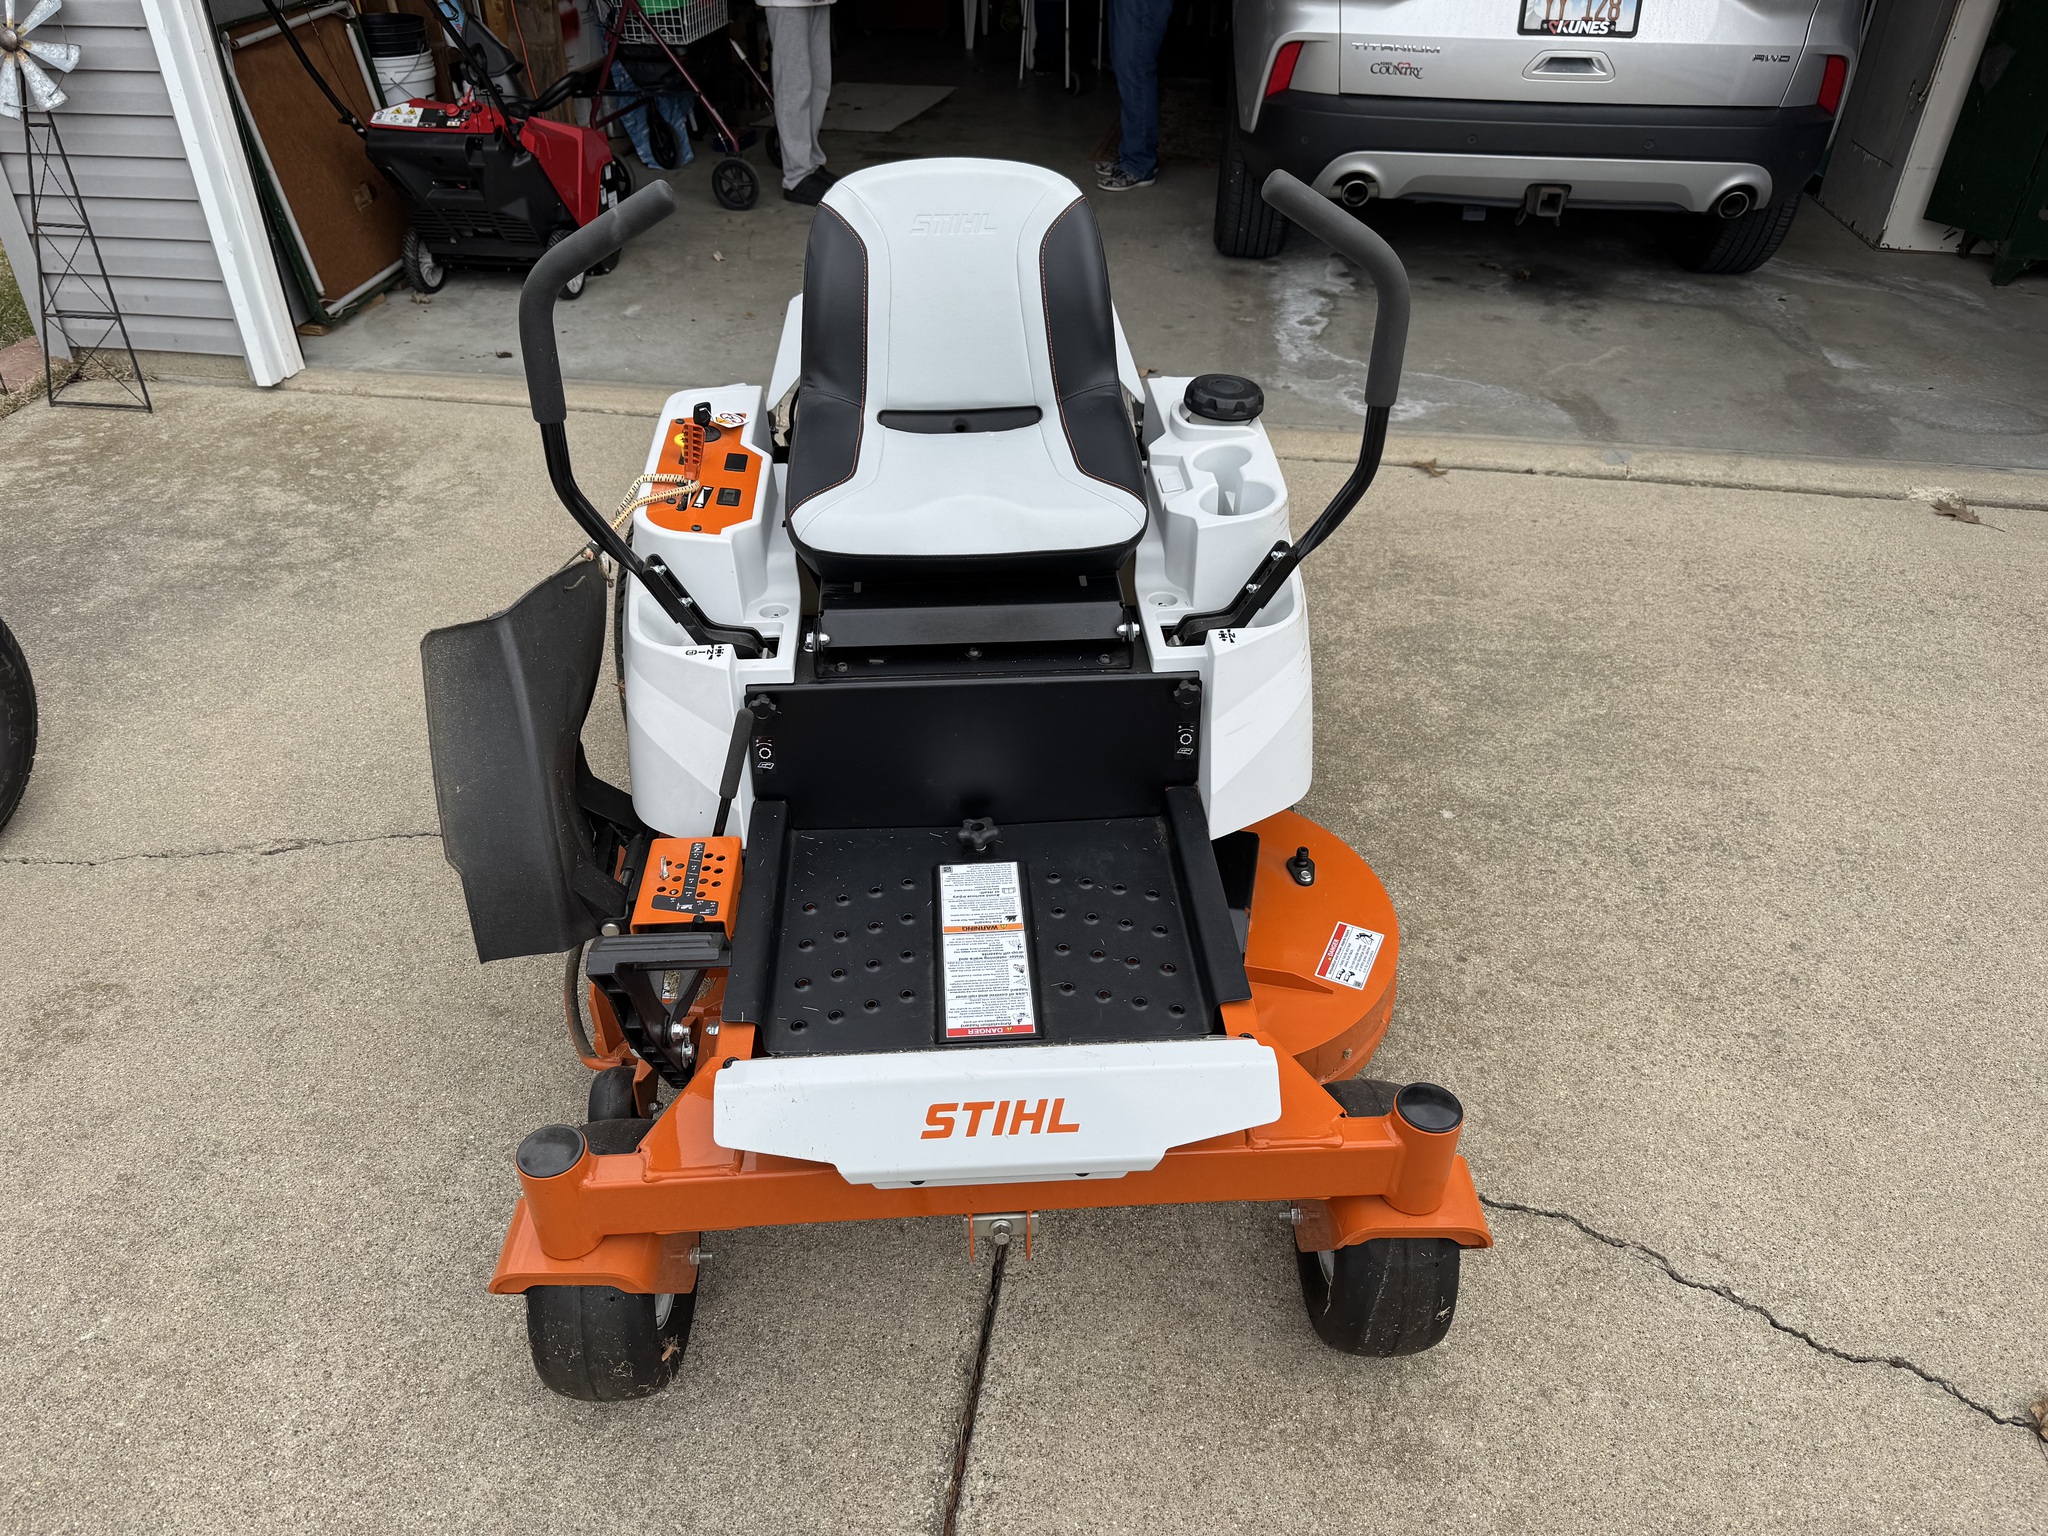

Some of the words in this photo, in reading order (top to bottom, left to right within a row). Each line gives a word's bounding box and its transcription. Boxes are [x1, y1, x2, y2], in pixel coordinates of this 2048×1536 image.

[1581, 0, 1622, 21] 128
[1556, 20, 1611, 35] KUNES
[1351, 42, 1441, 54] TITANIUM
[1751, 54, 1791, 63] AWD
[1370, 62, 1424, 80] COUNTRY
[910, 212, 998, 236] STIHL
[1328, 938, 1340, 957] DANGER
[920, 1098, 1080, 1140] STIHL
